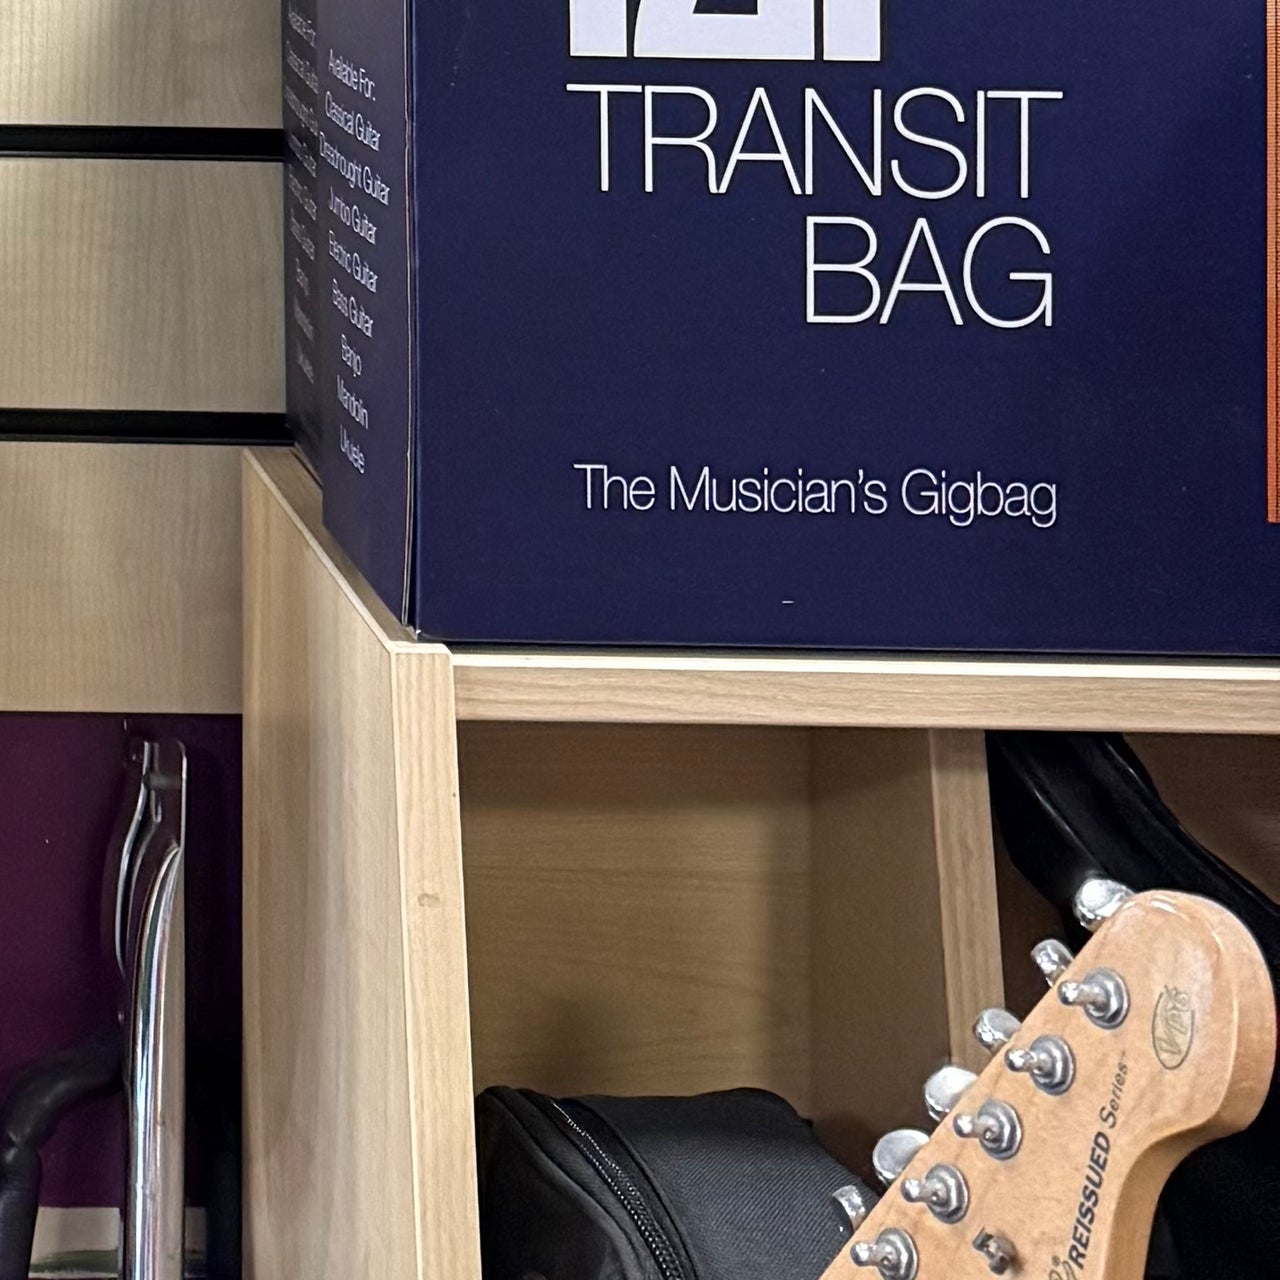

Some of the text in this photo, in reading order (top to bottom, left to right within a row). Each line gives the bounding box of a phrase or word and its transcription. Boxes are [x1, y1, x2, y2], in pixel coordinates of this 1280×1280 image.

[325, 90, 354, 135] Classical
[355, 113, 381, 152] Guitar
[566, 84, 1064, 201] TRANSIT
[363, 166, 390, 206] Guitar
[351, 205, 378, 245] Guitar
[328, 229, 351, 274] Electric
[352, 252, 378, 293] Guitar
[806, 215, 1054, 328] BAG
[332, 278, 348, 317] Bass
[348, 297, 373, 338] Guitar
[341, 333, 362, 378] Banjo
[337, 374, 369, 430] Mandolin
[340, 424, 365, 475] Ukulele
[574, 463, 1058, 527] The Musician's Gigbag
[1069, 1061, 1128, 1270] REISSUED Series
